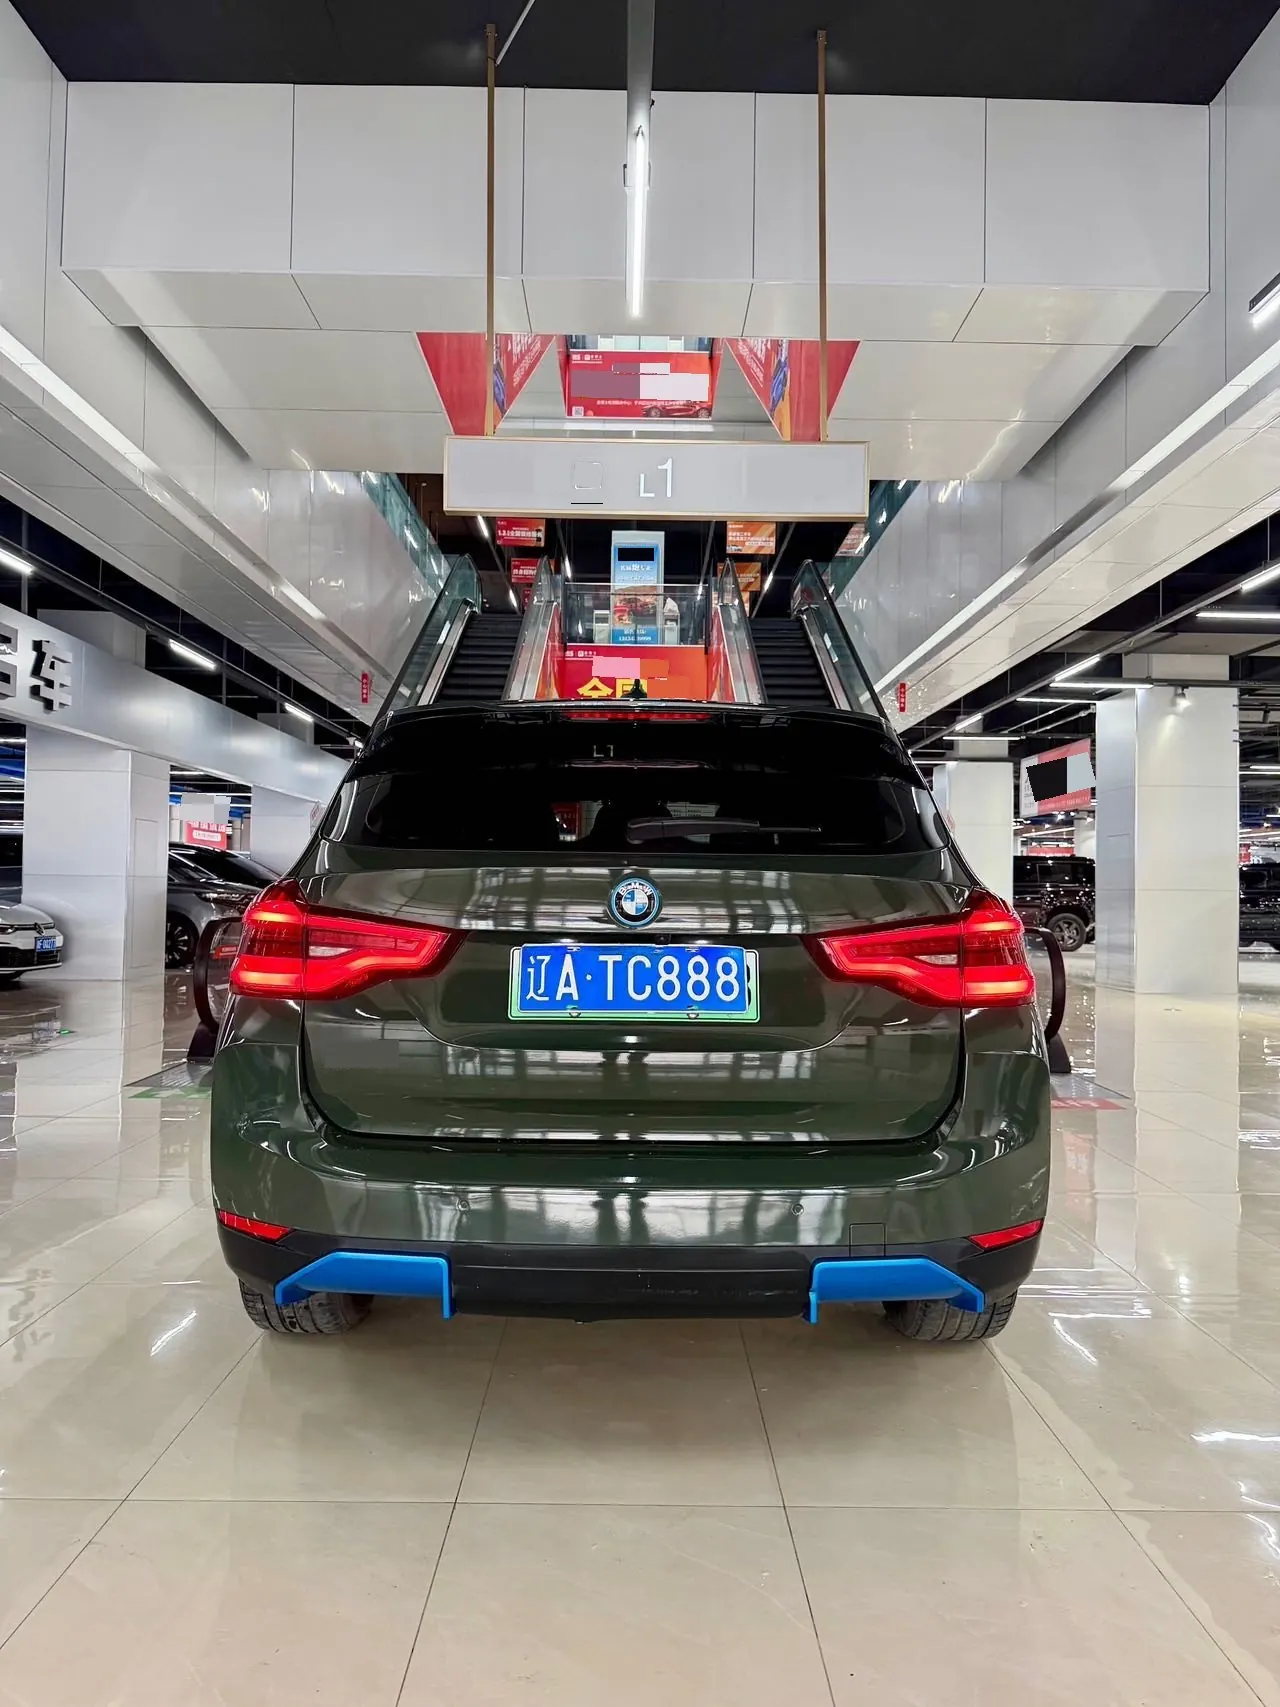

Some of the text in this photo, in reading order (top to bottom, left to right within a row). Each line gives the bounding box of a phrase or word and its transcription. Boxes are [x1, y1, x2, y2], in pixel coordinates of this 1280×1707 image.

[639, 457, 673, 498] L1
[618, 881, 653, 896] BMW
[525, 953, 740, 1002] 辽A·TC888
